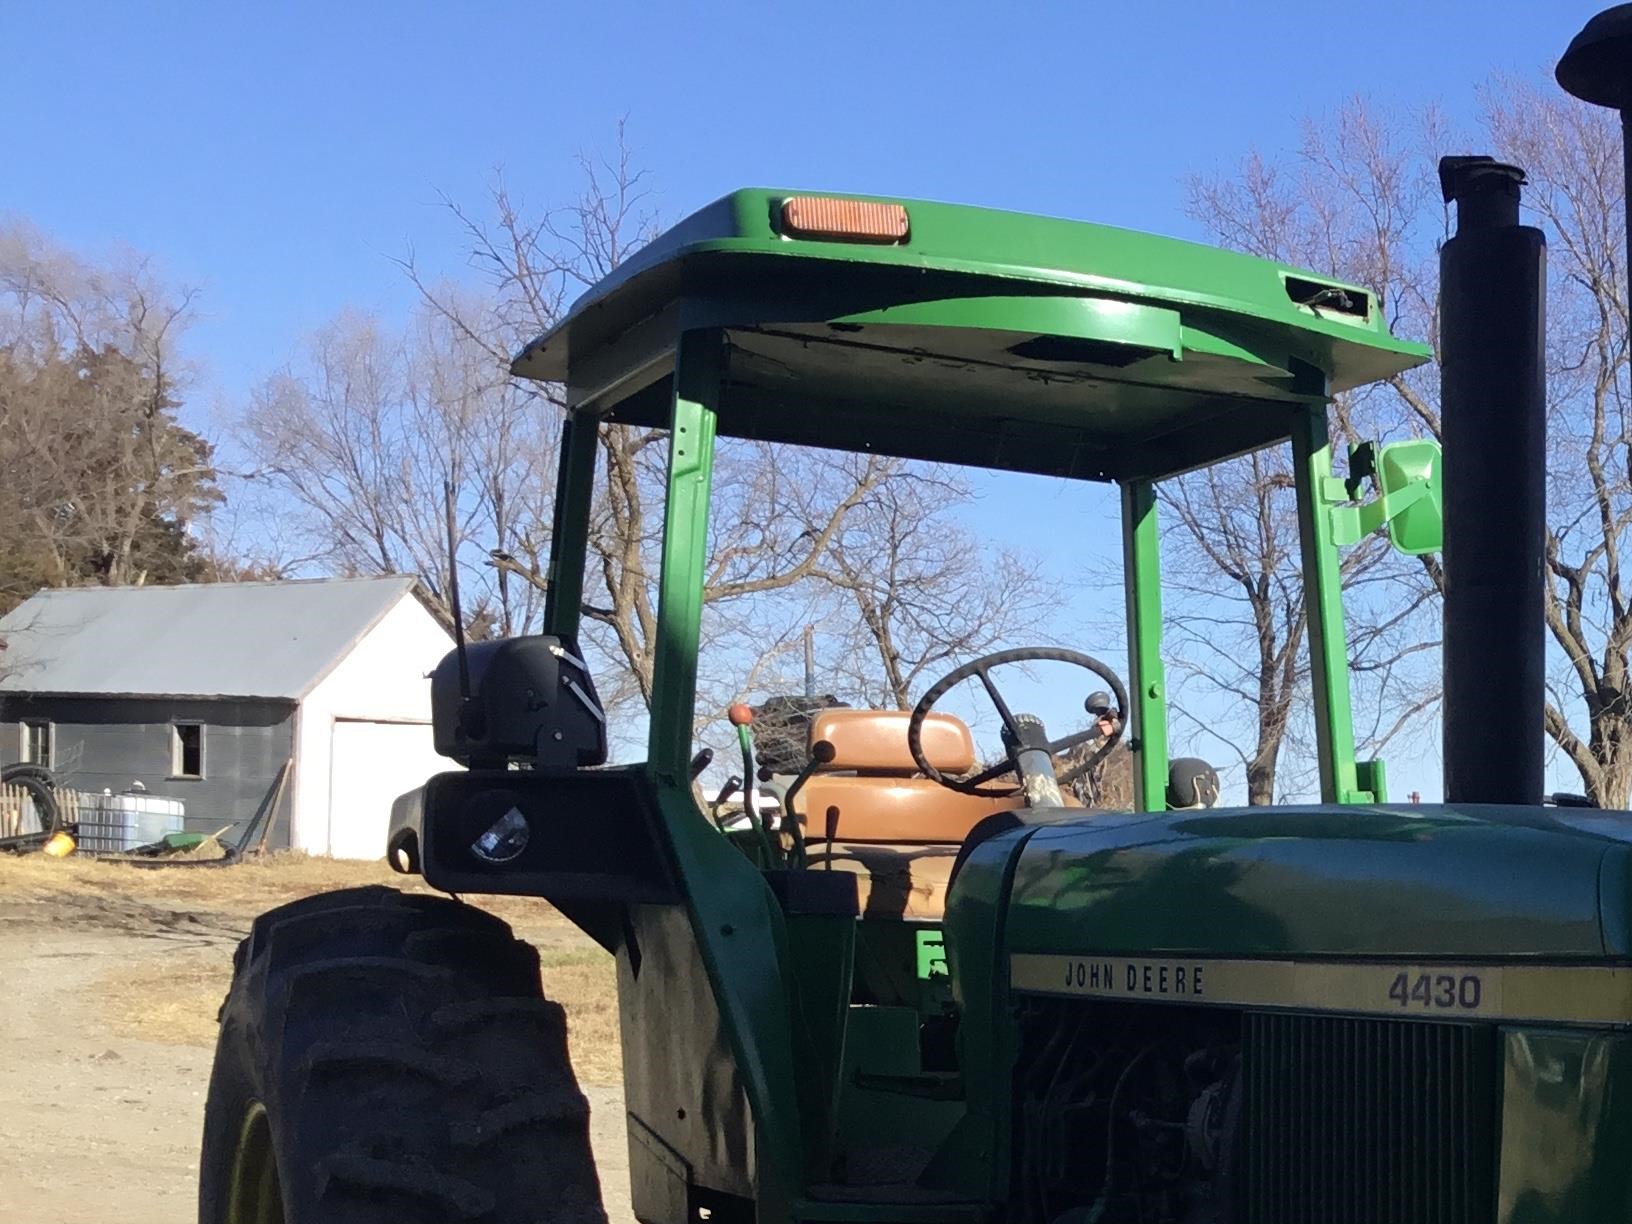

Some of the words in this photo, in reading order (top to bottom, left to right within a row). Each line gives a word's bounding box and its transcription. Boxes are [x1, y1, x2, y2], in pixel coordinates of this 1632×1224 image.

[1065, 962, 1114, 991] JOHN
[1127, 964, 1204, 996] DEERE
[1388, 972, 1482, 1010] 4430
